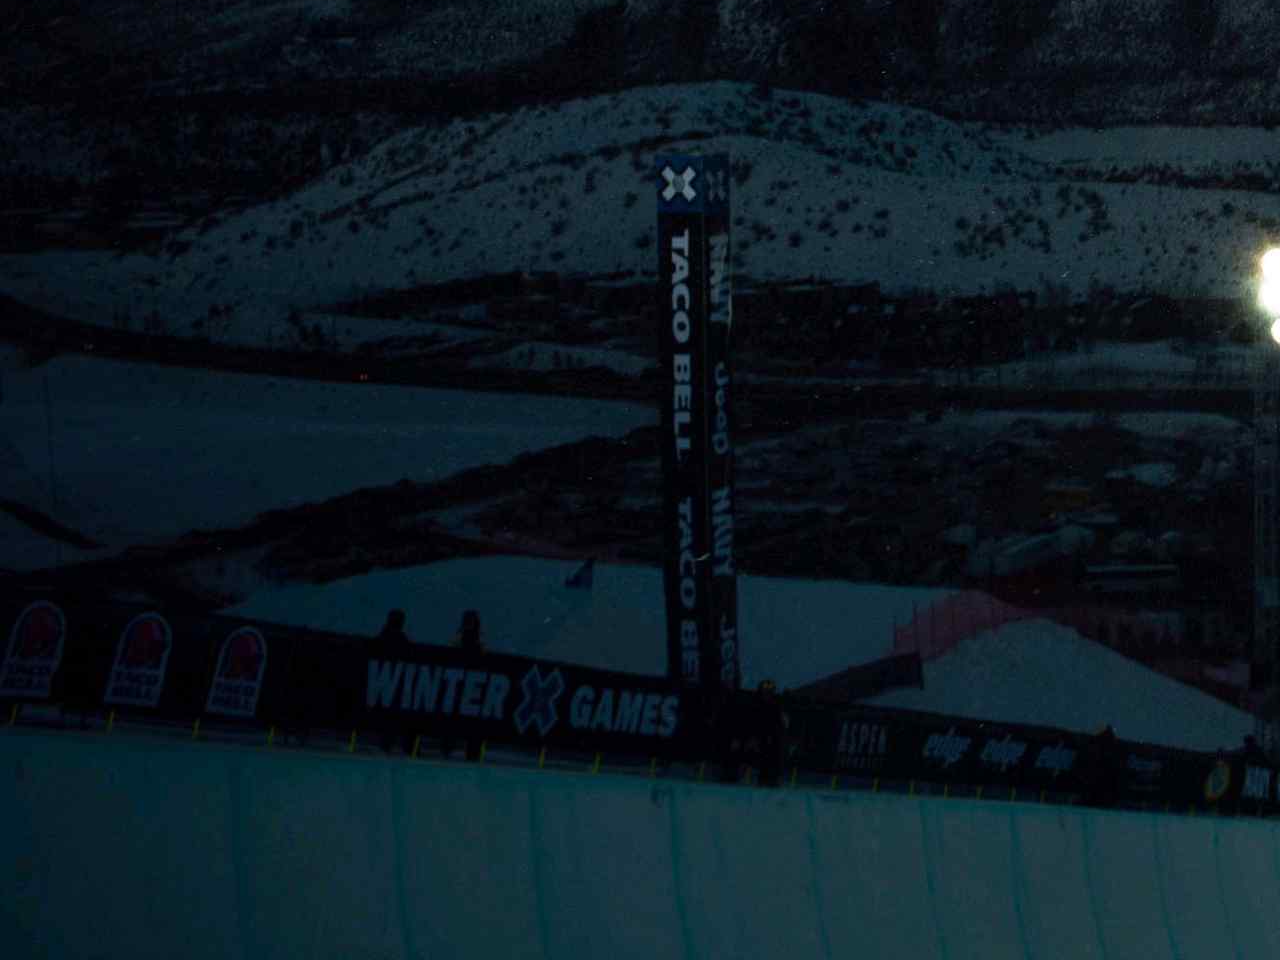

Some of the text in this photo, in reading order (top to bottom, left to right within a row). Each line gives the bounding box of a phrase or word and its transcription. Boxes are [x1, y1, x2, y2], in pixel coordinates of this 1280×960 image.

[671, 227, 694, 463] TACO BELL
[678, 495, 697, 609] TACO
[365, 656, 512, 720] WINTER
[569, 684, 681, 739] GAMES
